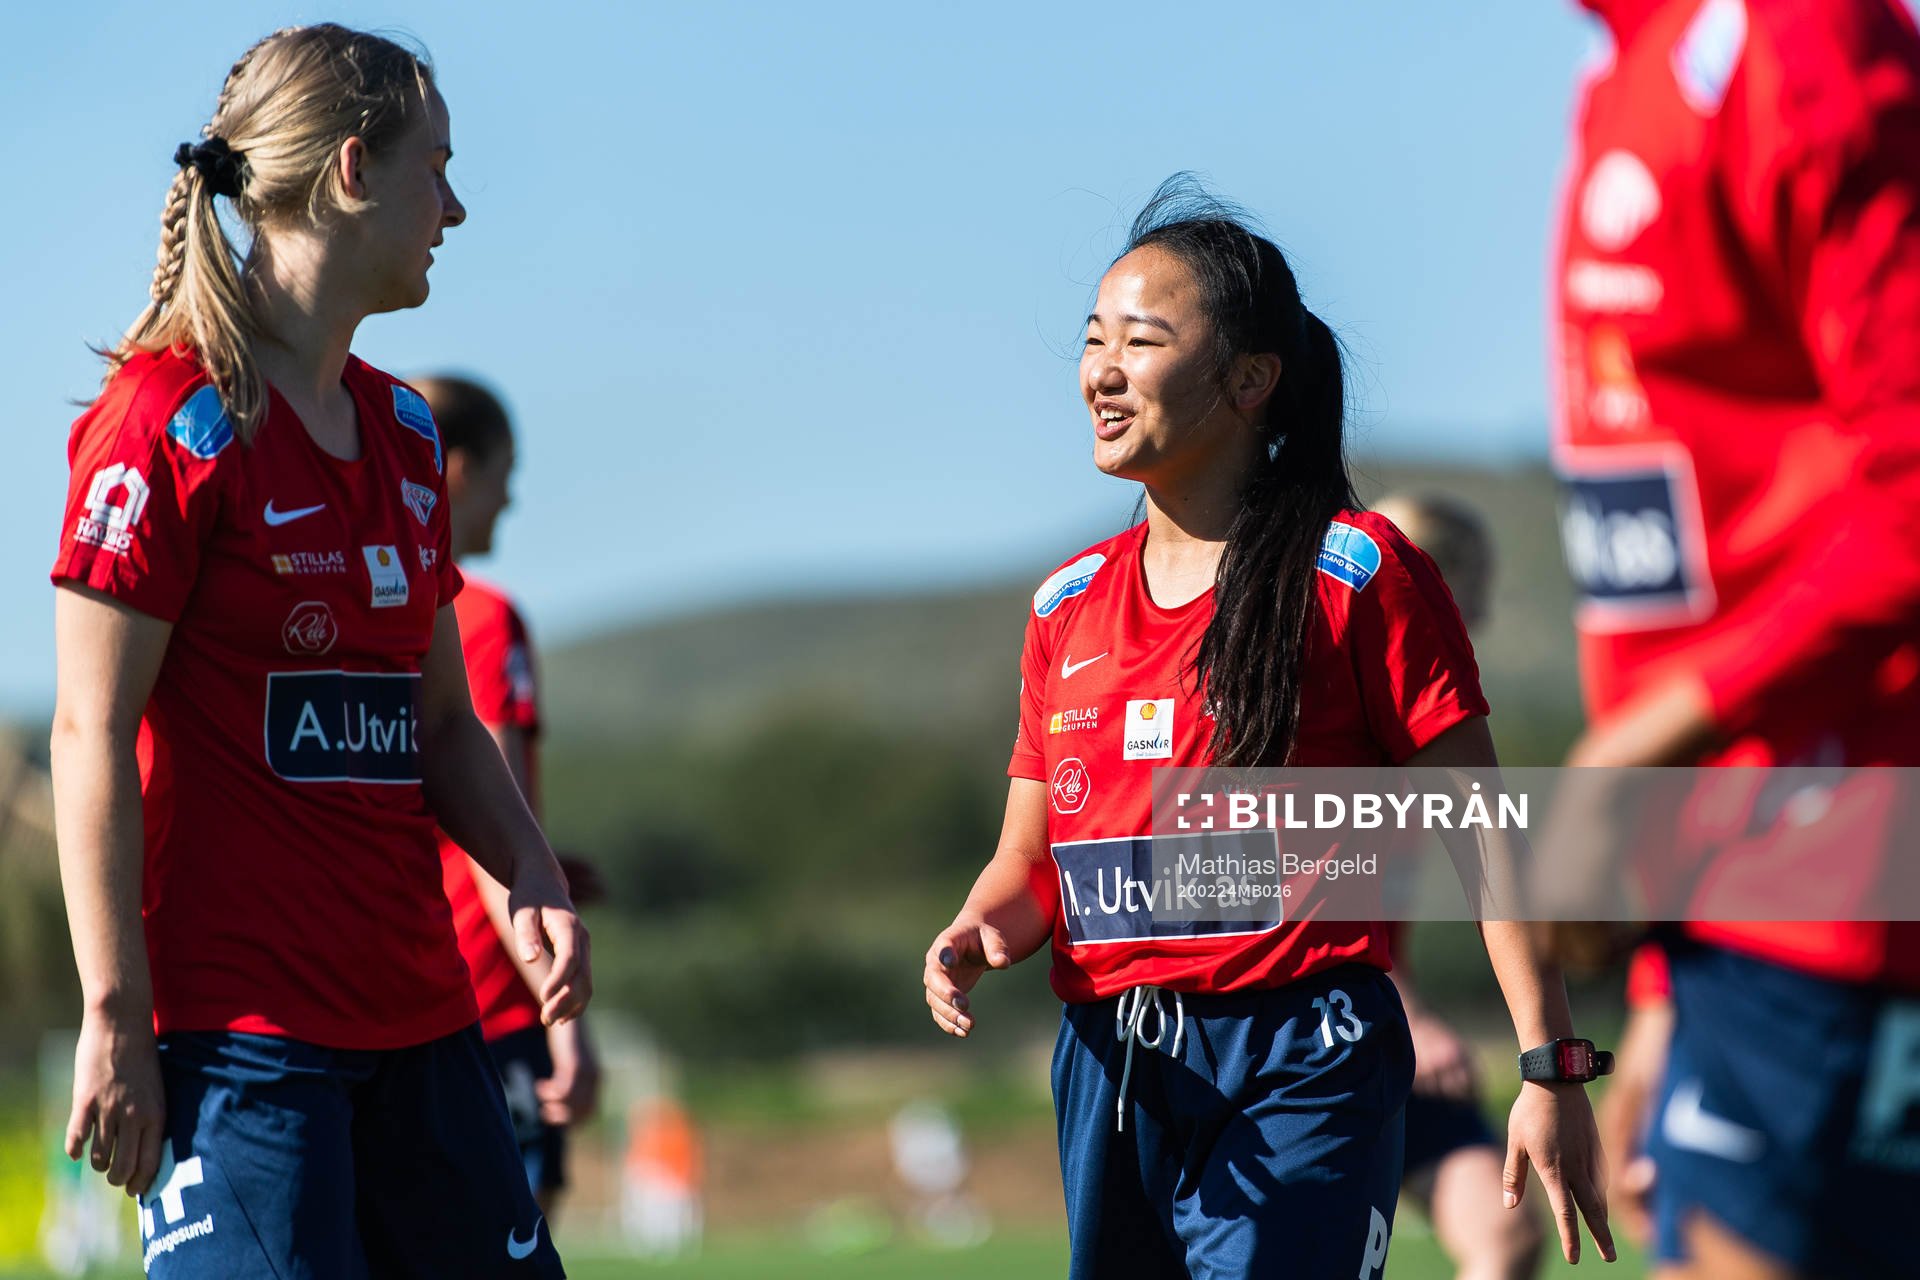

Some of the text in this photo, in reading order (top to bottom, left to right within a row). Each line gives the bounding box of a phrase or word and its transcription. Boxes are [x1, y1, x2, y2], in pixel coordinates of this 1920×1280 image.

[291, 551, 345, 566] STILLAS
[1063, 706, 1098, 723] STILLAS
[1062, 721, 1097, 732] GRUPPEN
[1097, 863, 1202, 915] Utvik
[1215, 873, 1259, 908] as
[1312, 989, 1363, 1049] 13
